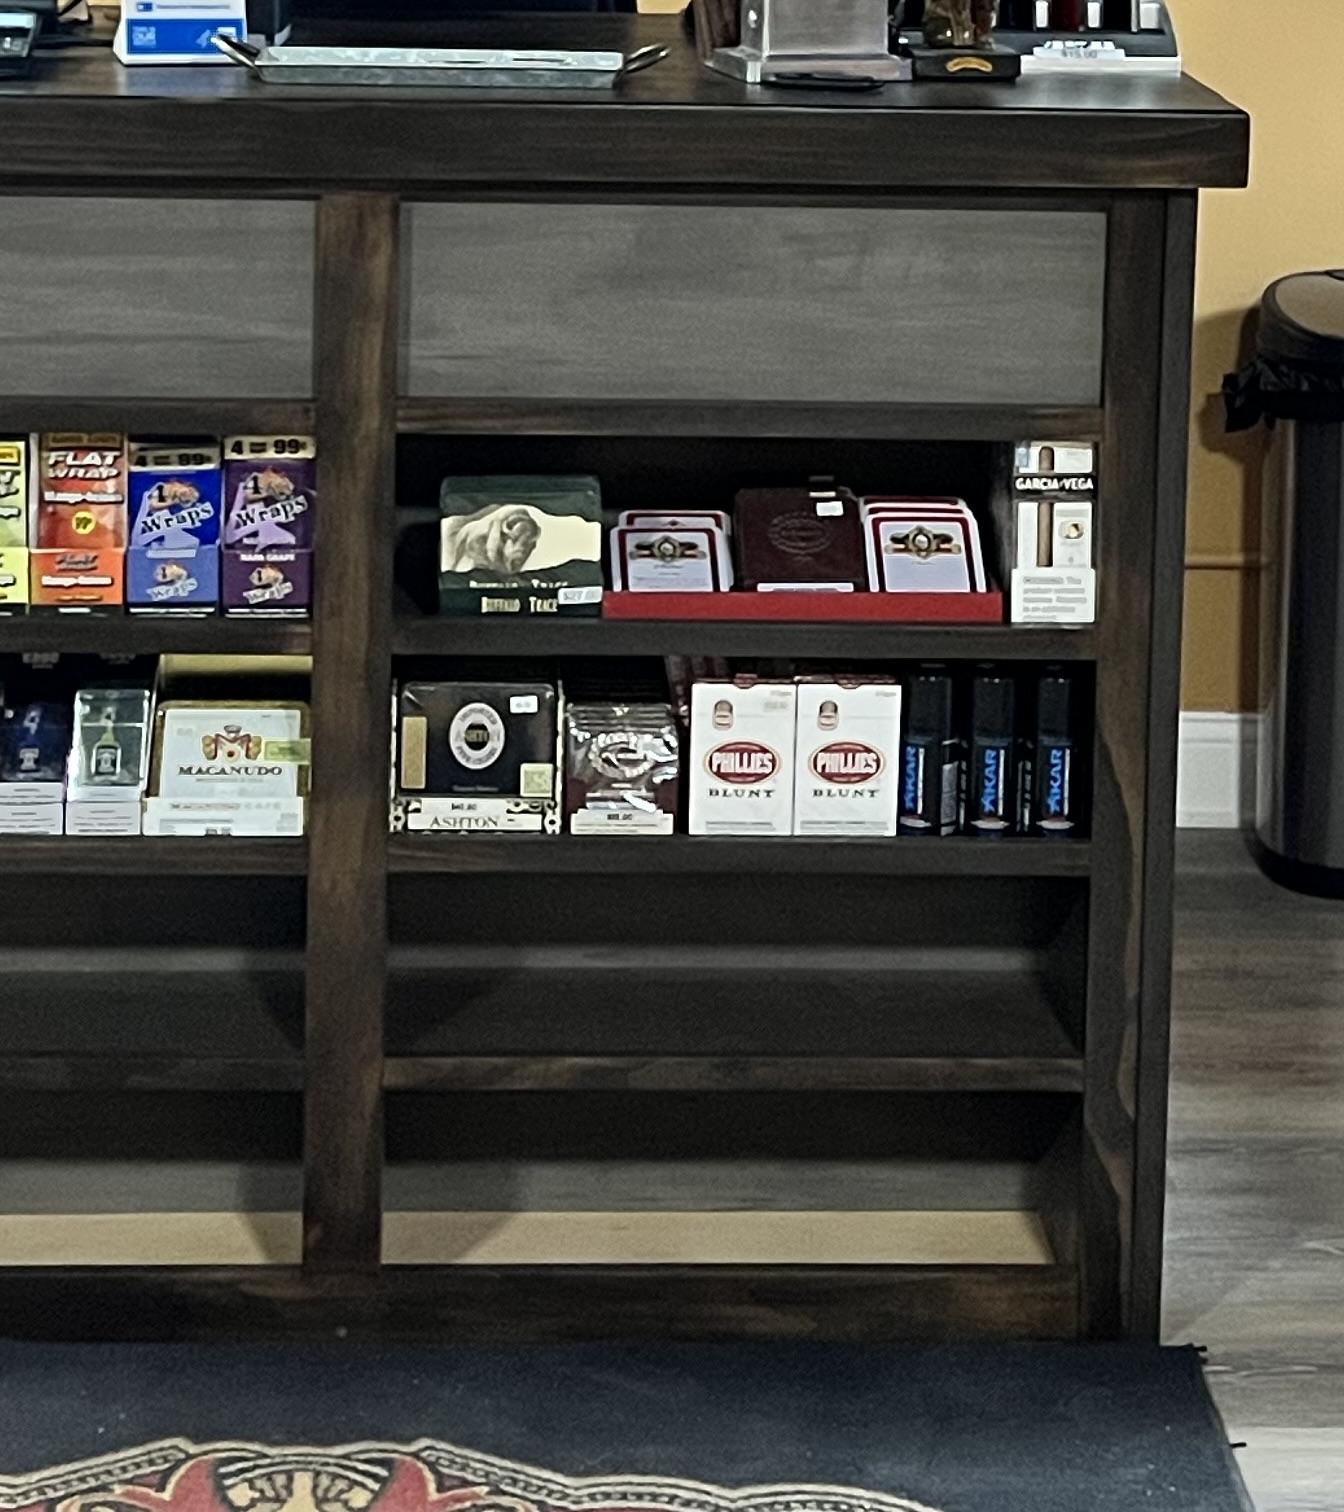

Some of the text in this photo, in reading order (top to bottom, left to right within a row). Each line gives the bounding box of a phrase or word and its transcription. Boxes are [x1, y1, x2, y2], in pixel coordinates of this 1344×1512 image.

[231, 439, 244, 454] 4
[48, 450, 122, 466] FLAT
[135, 454, 148, 467] 4
[48, 466, 121, 480] WRAP
[1015, 477, 1094, 490] GARCIA VEGA
[141, 501, 215, 534] Wraps
[235, 495, 308, 528] Wraps
[146, 579, 199, 601] Wraps
[243, 583, 294, 605] Wraps
[529, 596, 557, 613] TRAC
[712, 752, 773, 774] PHILLIES
[816, 752, 878, 774] PHILLIES
[178, 766, 283, 776] MACANUDO
[709, 789, 775, 798] BLUNT
[813, 789, 880, 798] BLUNT
[430, 815, 499, 829] ASHTON
